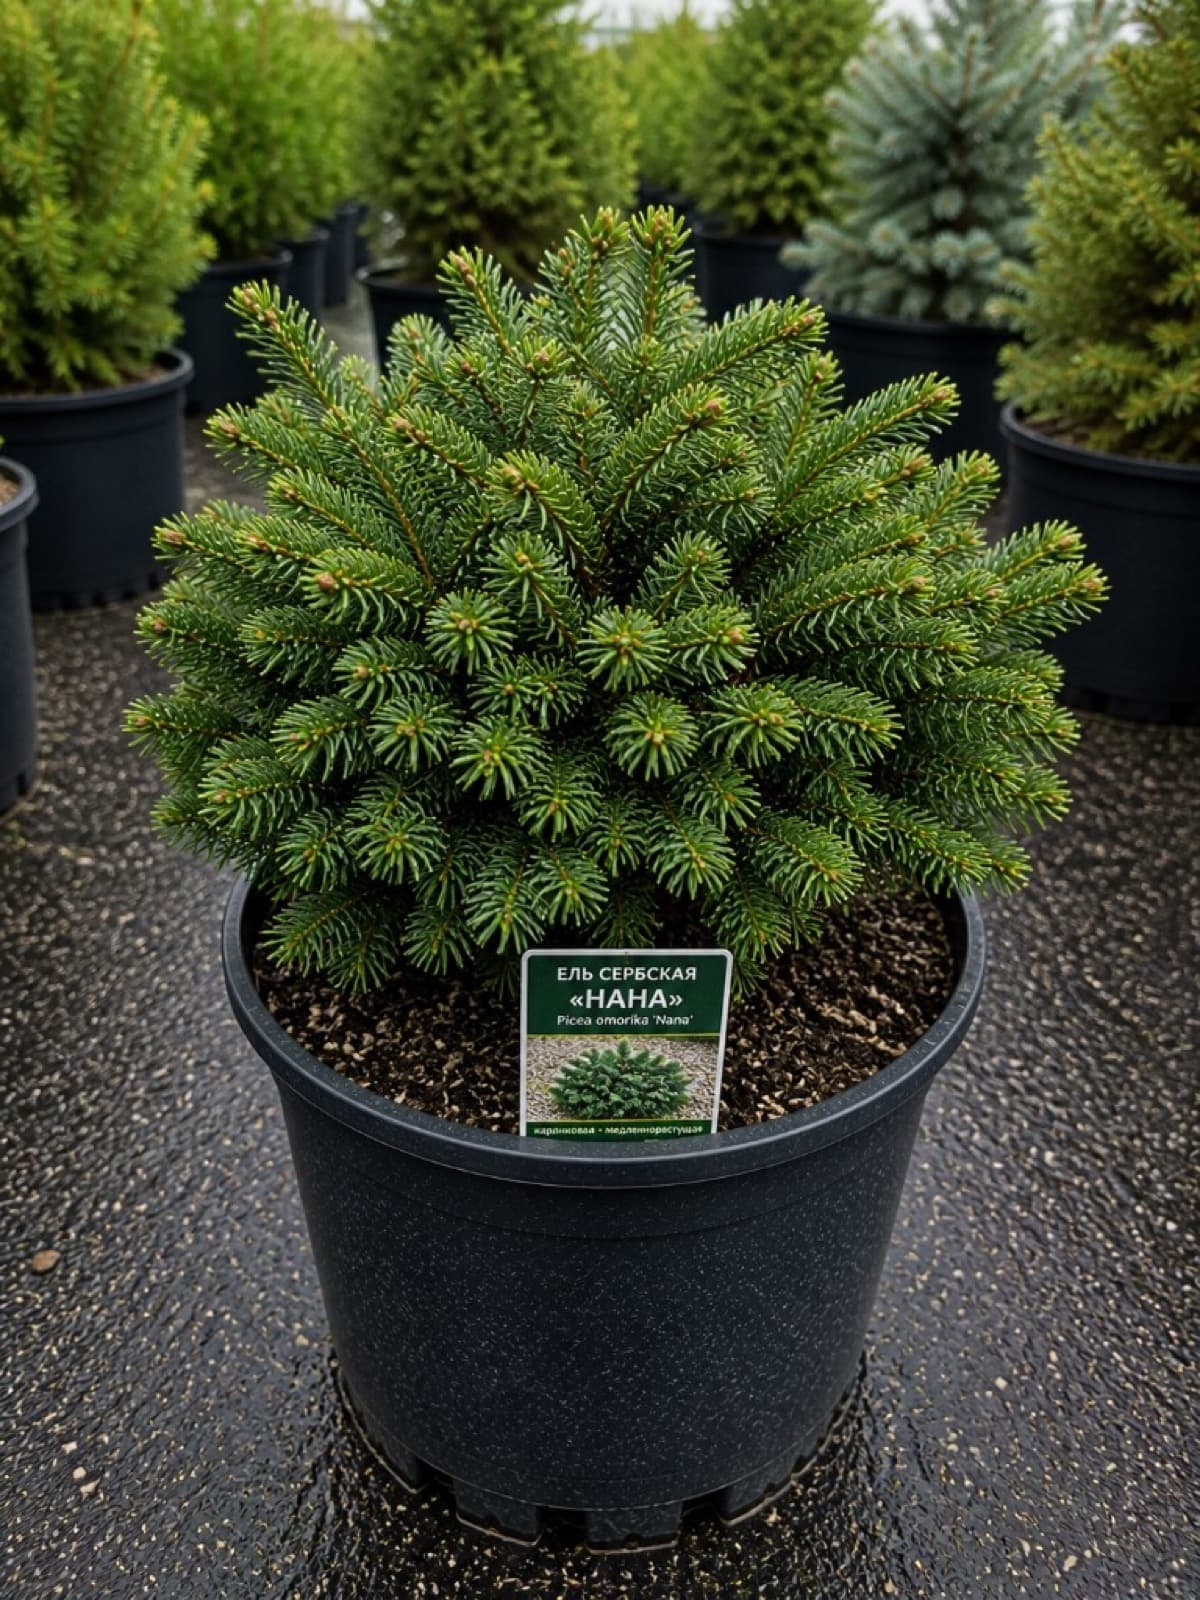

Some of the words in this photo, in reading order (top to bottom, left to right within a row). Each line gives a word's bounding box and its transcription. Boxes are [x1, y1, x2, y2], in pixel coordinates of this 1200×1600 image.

[557, 967, 593, 981] ЕЛЬ
[600, 966, 697, 981] СЕРБСКАЯ
[570, 988, 683, 1009] «НАНА»
[557, 1014, 592, 1026] Picea
[596, 1013, 649, 1026] omorika
